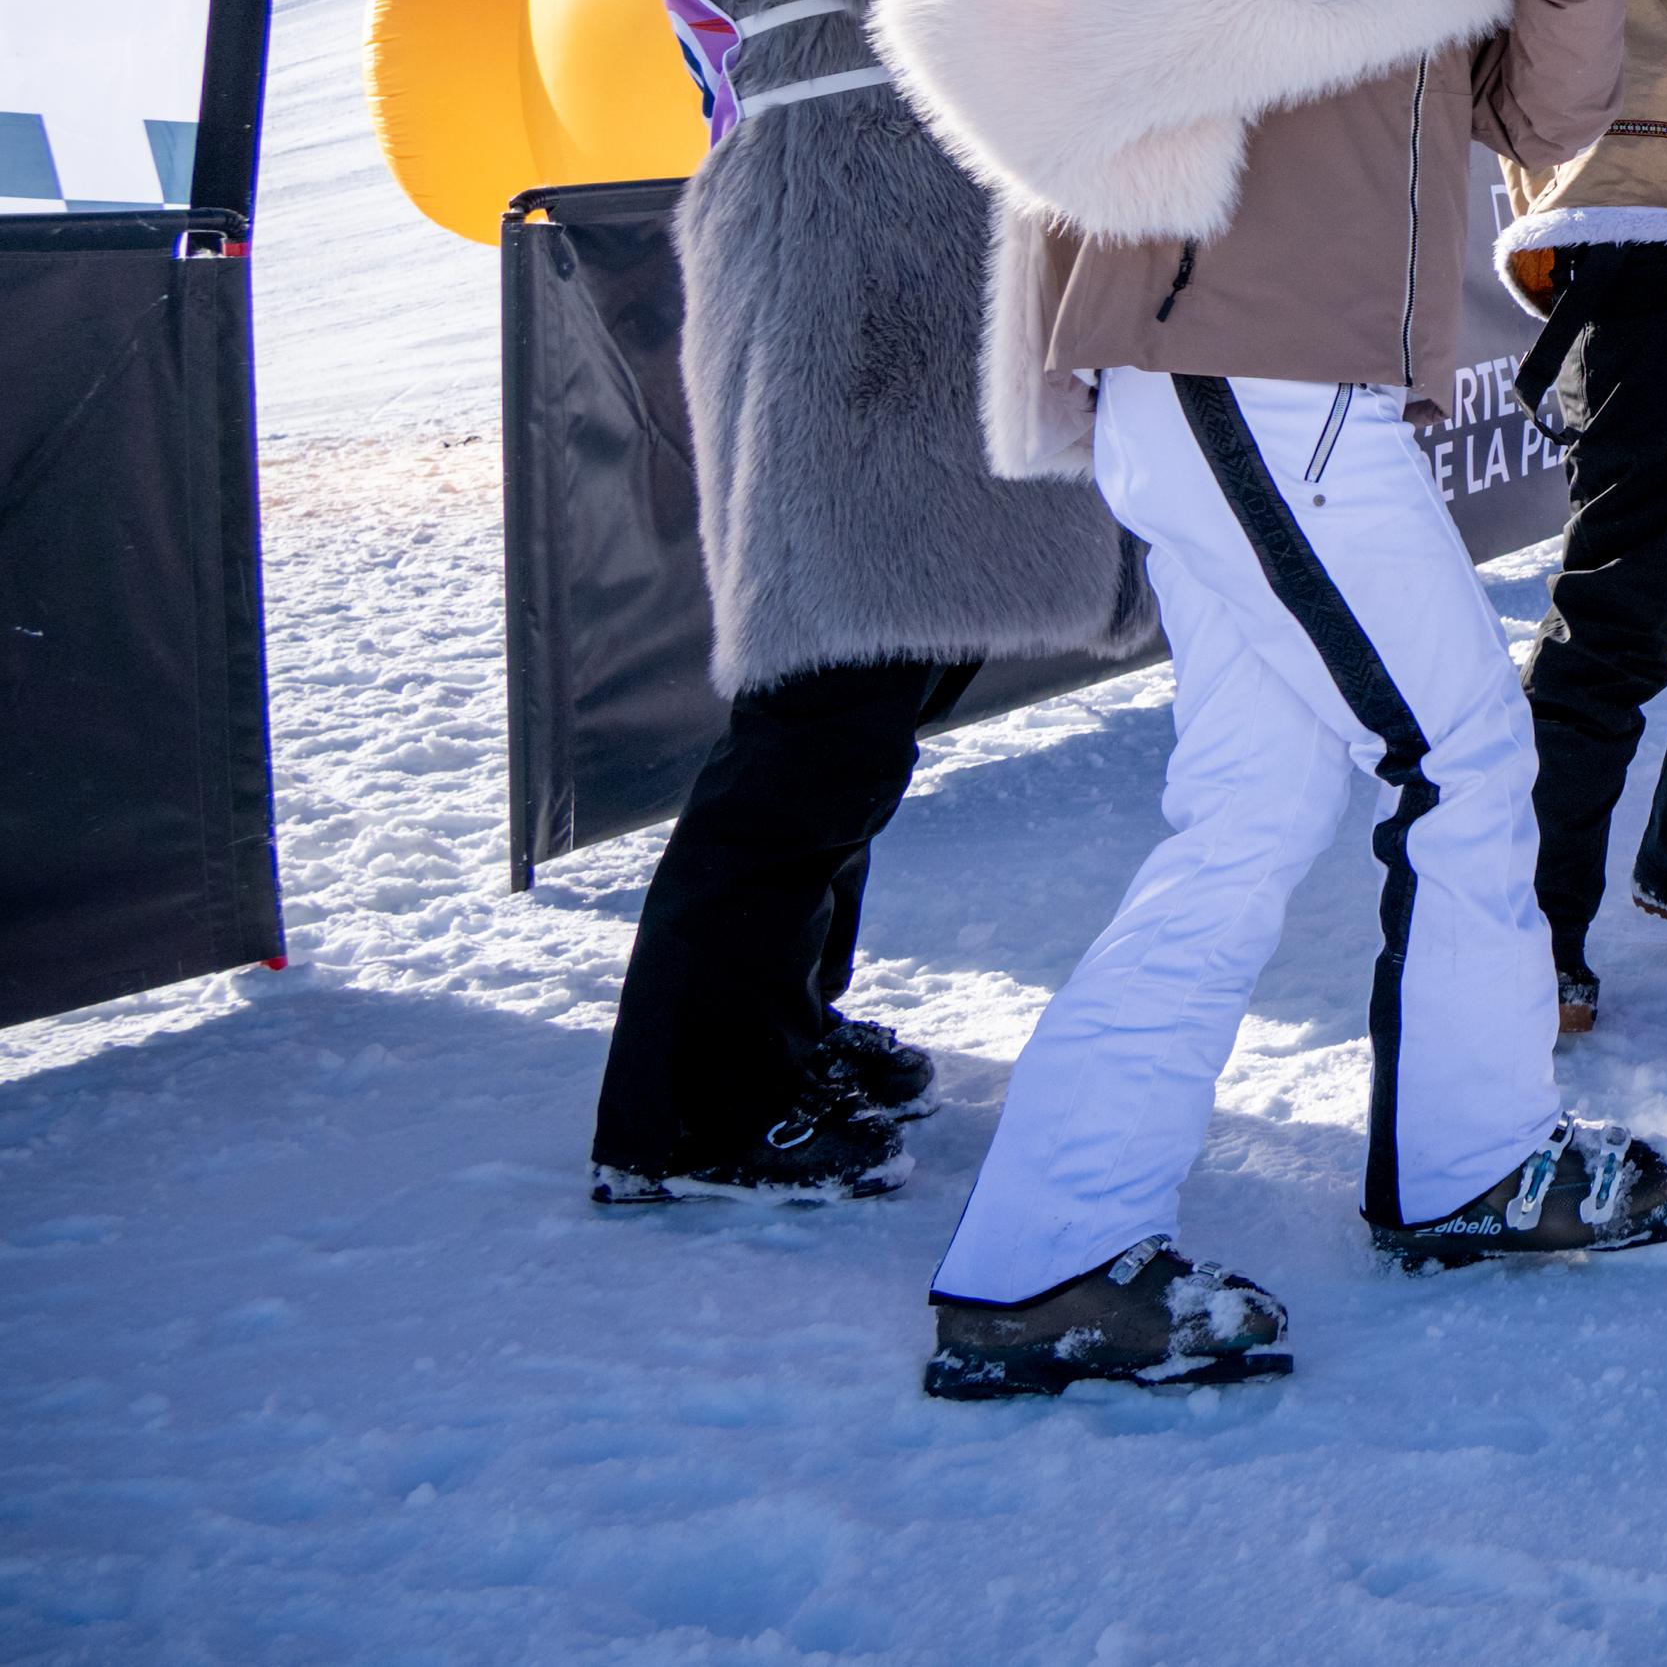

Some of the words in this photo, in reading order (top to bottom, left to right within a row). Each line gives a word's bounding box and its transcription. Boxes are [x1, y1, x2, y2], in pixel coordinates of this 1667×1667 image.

[1425, 440, 1455, 503] E
[1466, 426, 1511, 495] LA
[1415, 1215, 1502, 1236] albello
